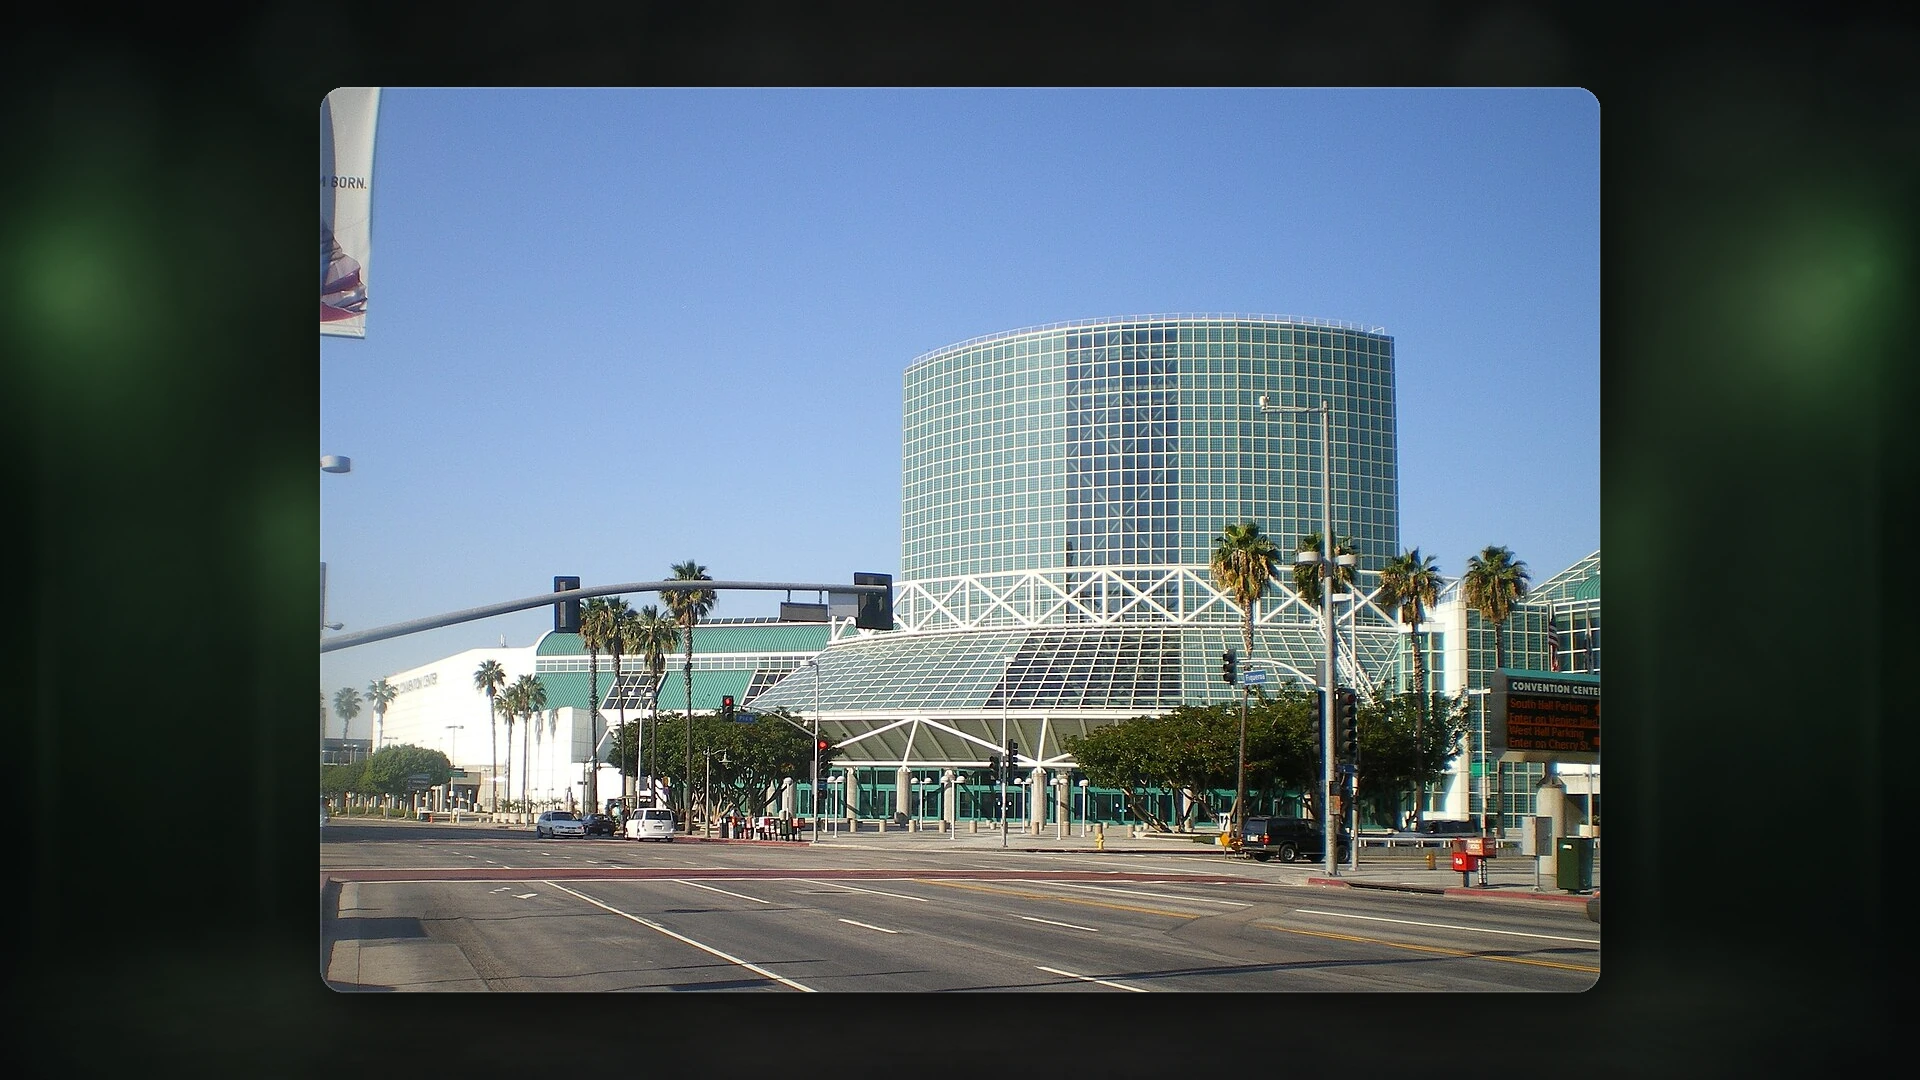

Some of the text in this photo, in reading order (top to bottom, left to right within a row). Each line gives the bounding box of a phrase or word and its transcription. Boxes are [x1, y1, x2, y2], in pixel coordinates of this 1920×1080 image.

[331, 176, 367, 189] BORN.
[1512, 681, 1570, 694] CONVENTION
[1510, 698, 1588, 714] South Hall Parking
[1509, 713, 1532, 723] Enter
[1534, 727, 1550, 737] Hall
[1551, 728, 1584, 740] Parking
[1509, 738, 1532, 748] Enter
[1548, 740, 1578, 750] Cherry
